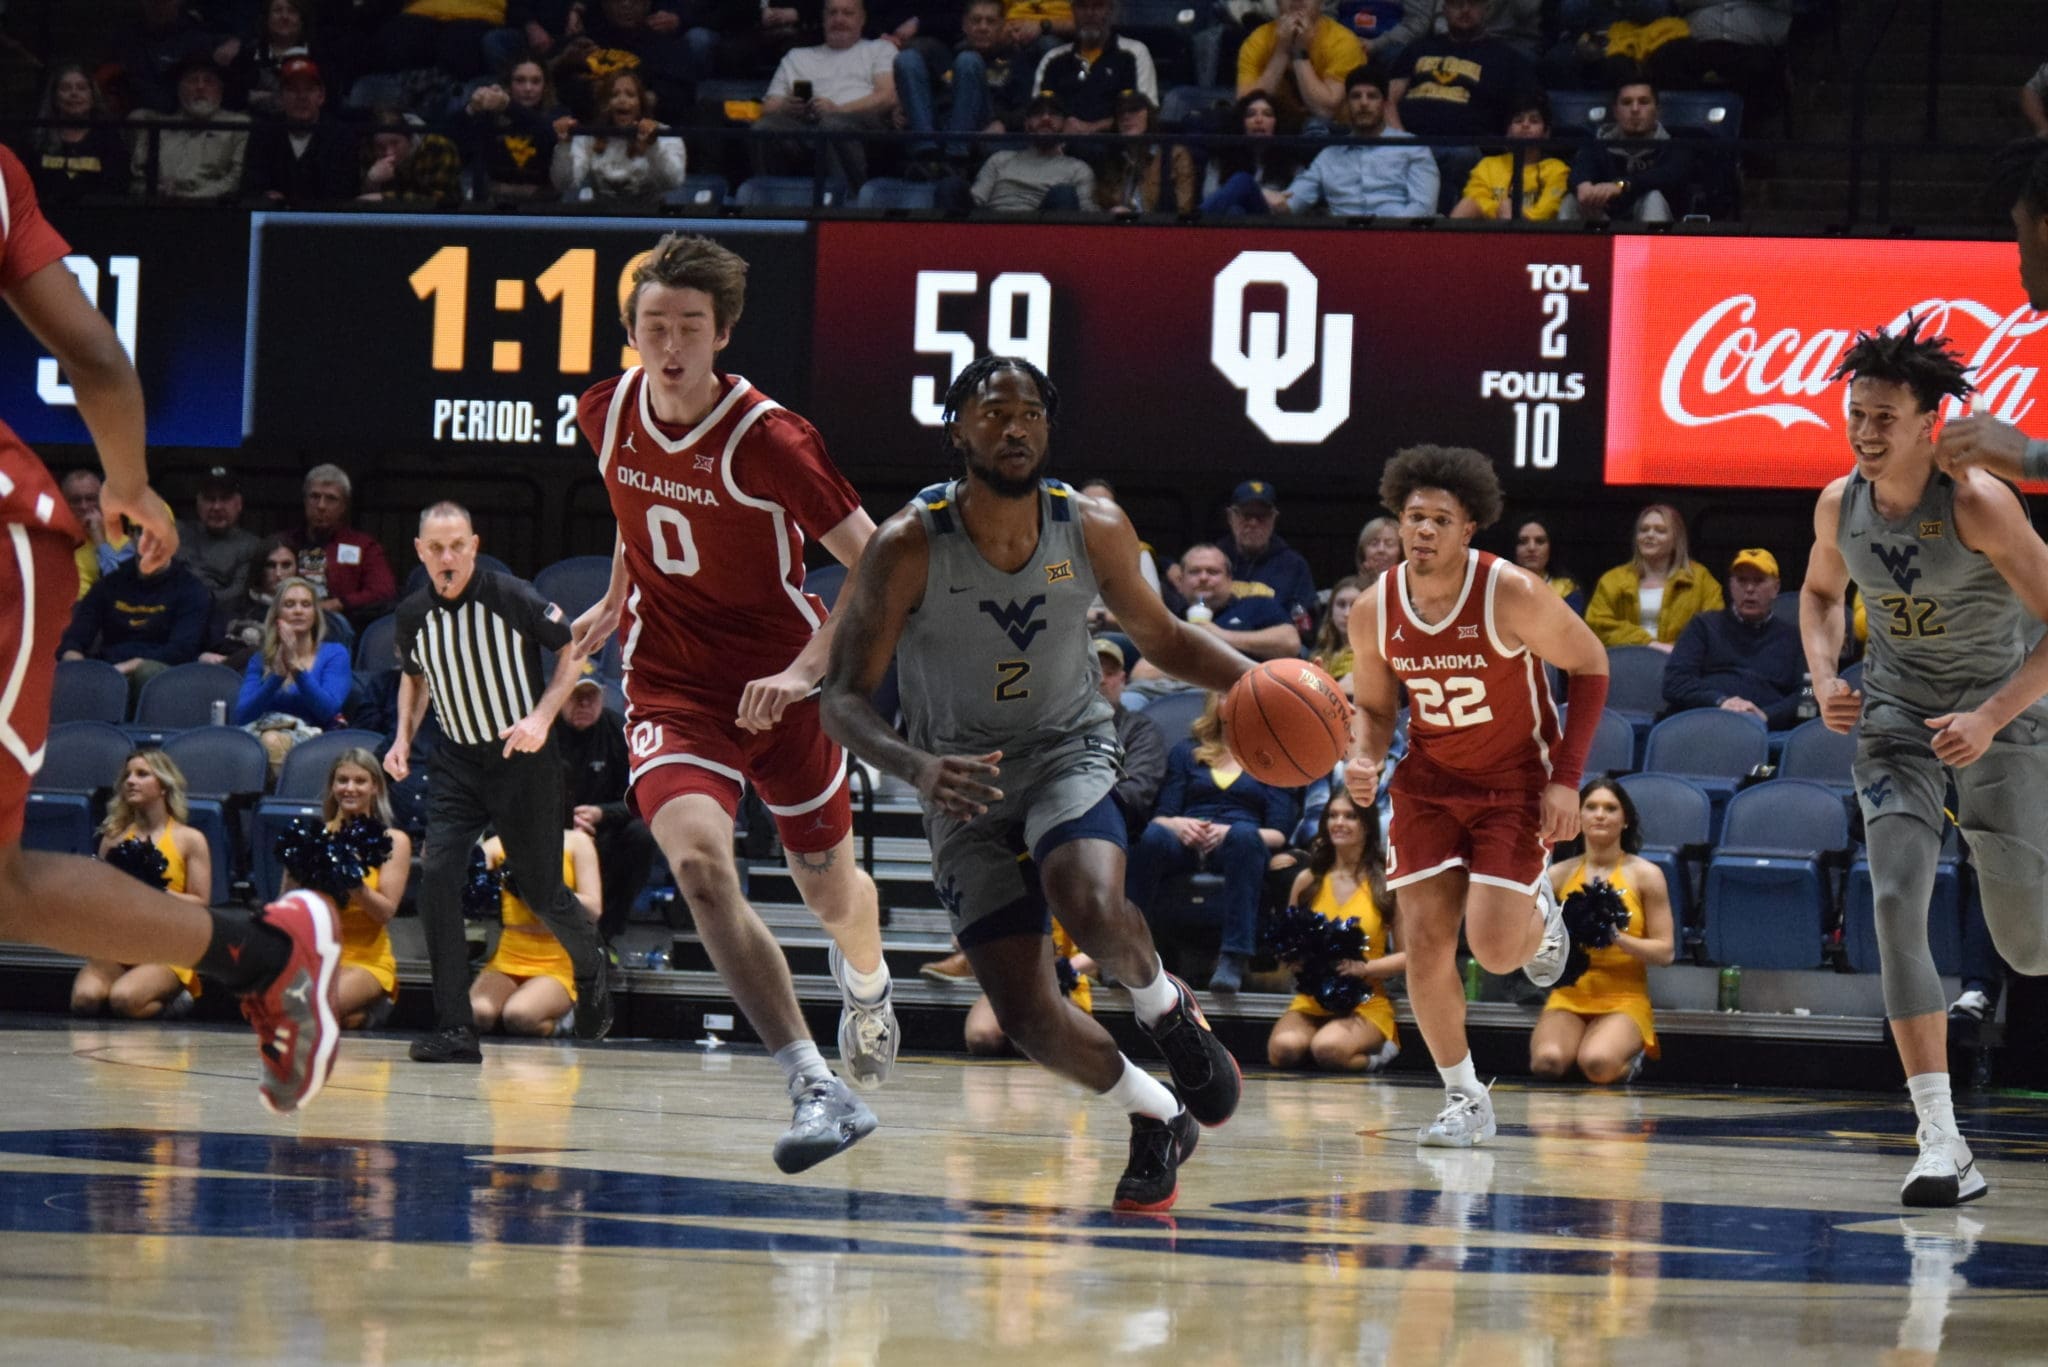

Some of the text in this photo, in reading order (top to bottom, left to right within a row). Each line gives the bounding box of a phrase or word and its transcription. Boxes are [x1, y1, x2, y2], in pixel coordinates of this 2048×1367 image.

[1526, 263, 1589, 291] TOL
[1211, 250, 1353, 444] OU
[1541, 292, 1569, 358] 2
[1481, 370, 1586, 400] FOULS
[433, 394, 578, 446] PERIOD: 2
[1514, 402, 1560, 468] 10
[617, 466, 720, 507] OKLAHOMA
[646, 504, 701, 577] 0
[1880, 594, 1947, 638] 32
[995, 658, 1032, 703] 2
[1392, 654, 1489, 671] OKLAHOMA
[1406, 676, 1494, 728] 22
[631, 721, 663, 757] OU
